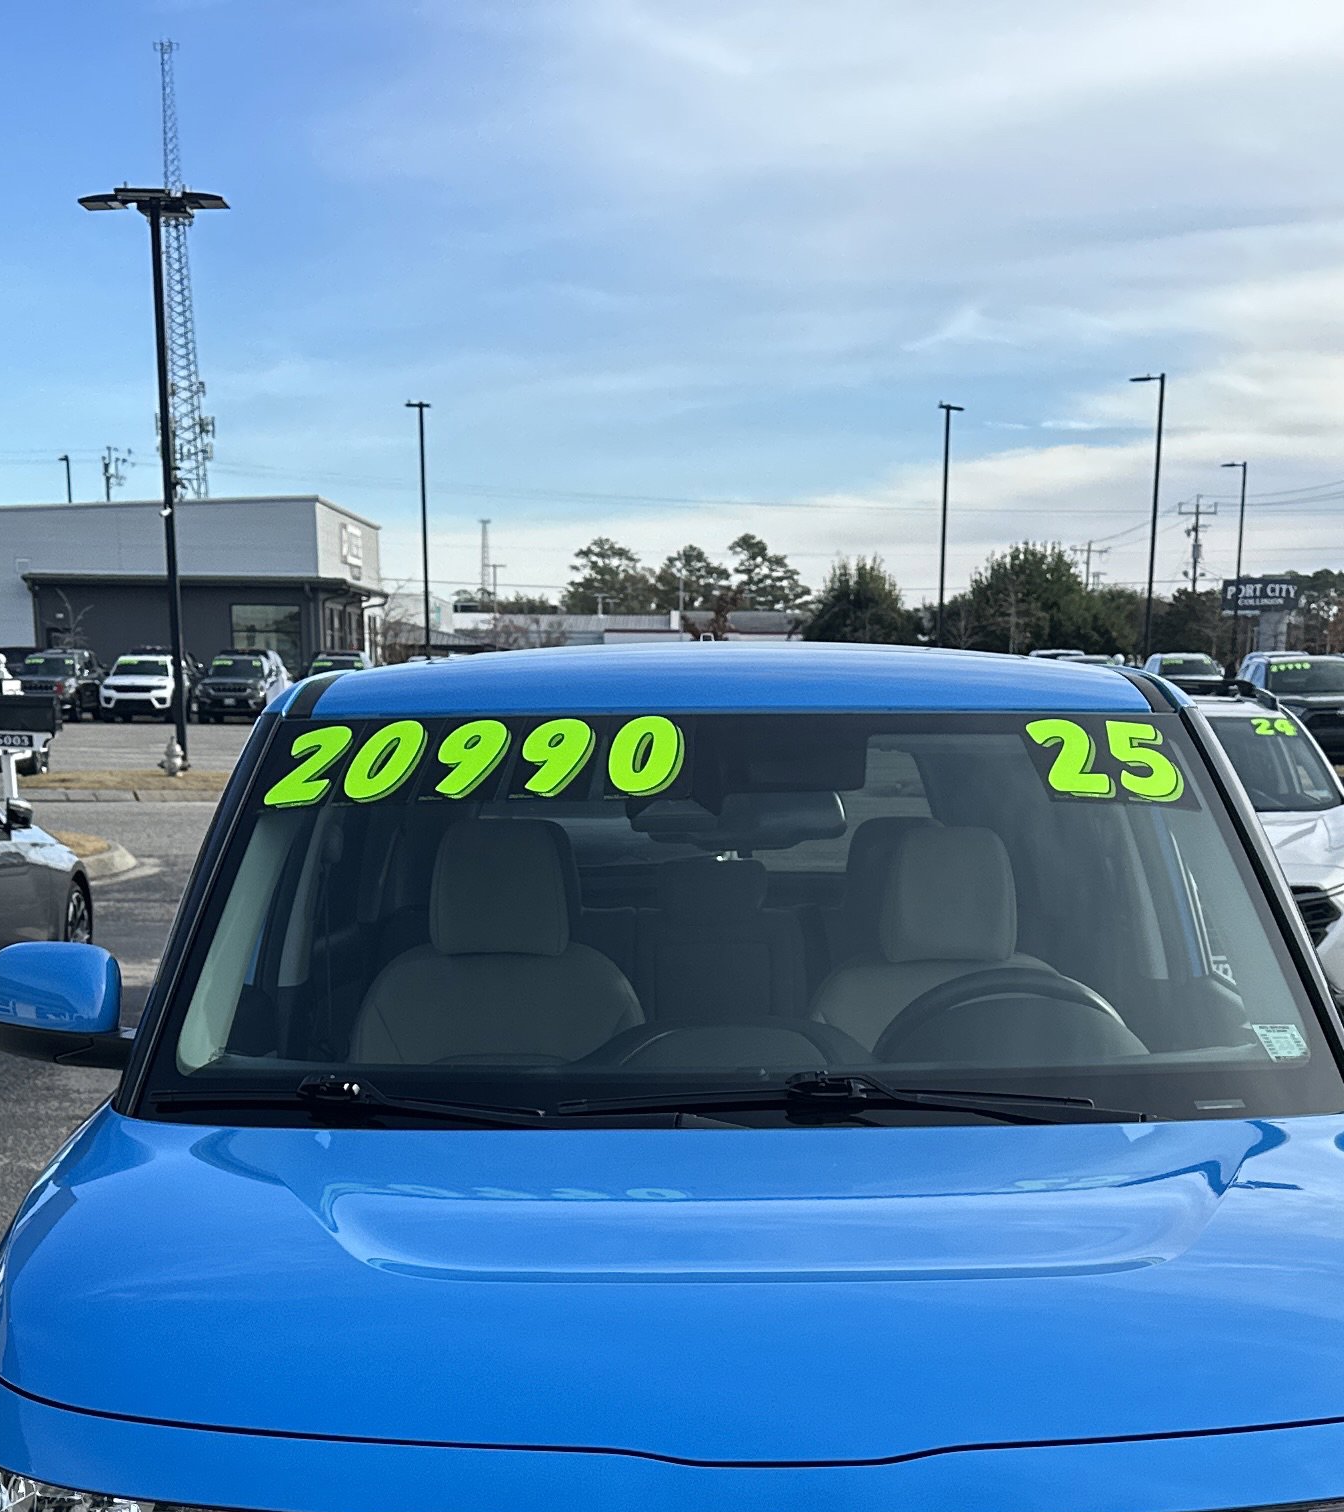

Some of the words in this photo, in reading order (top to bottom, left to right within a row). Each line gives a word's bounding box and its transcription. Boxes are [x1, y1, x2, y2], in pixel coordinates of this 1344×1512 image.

[1226, 583, 1263, 599] PORT
[1266, 583, 1298, 599] CITY
[1251, 718, 1298, 737] 24
[264, 716, 684, 807] 20990
[1026, 719, 1185, 802] 25
